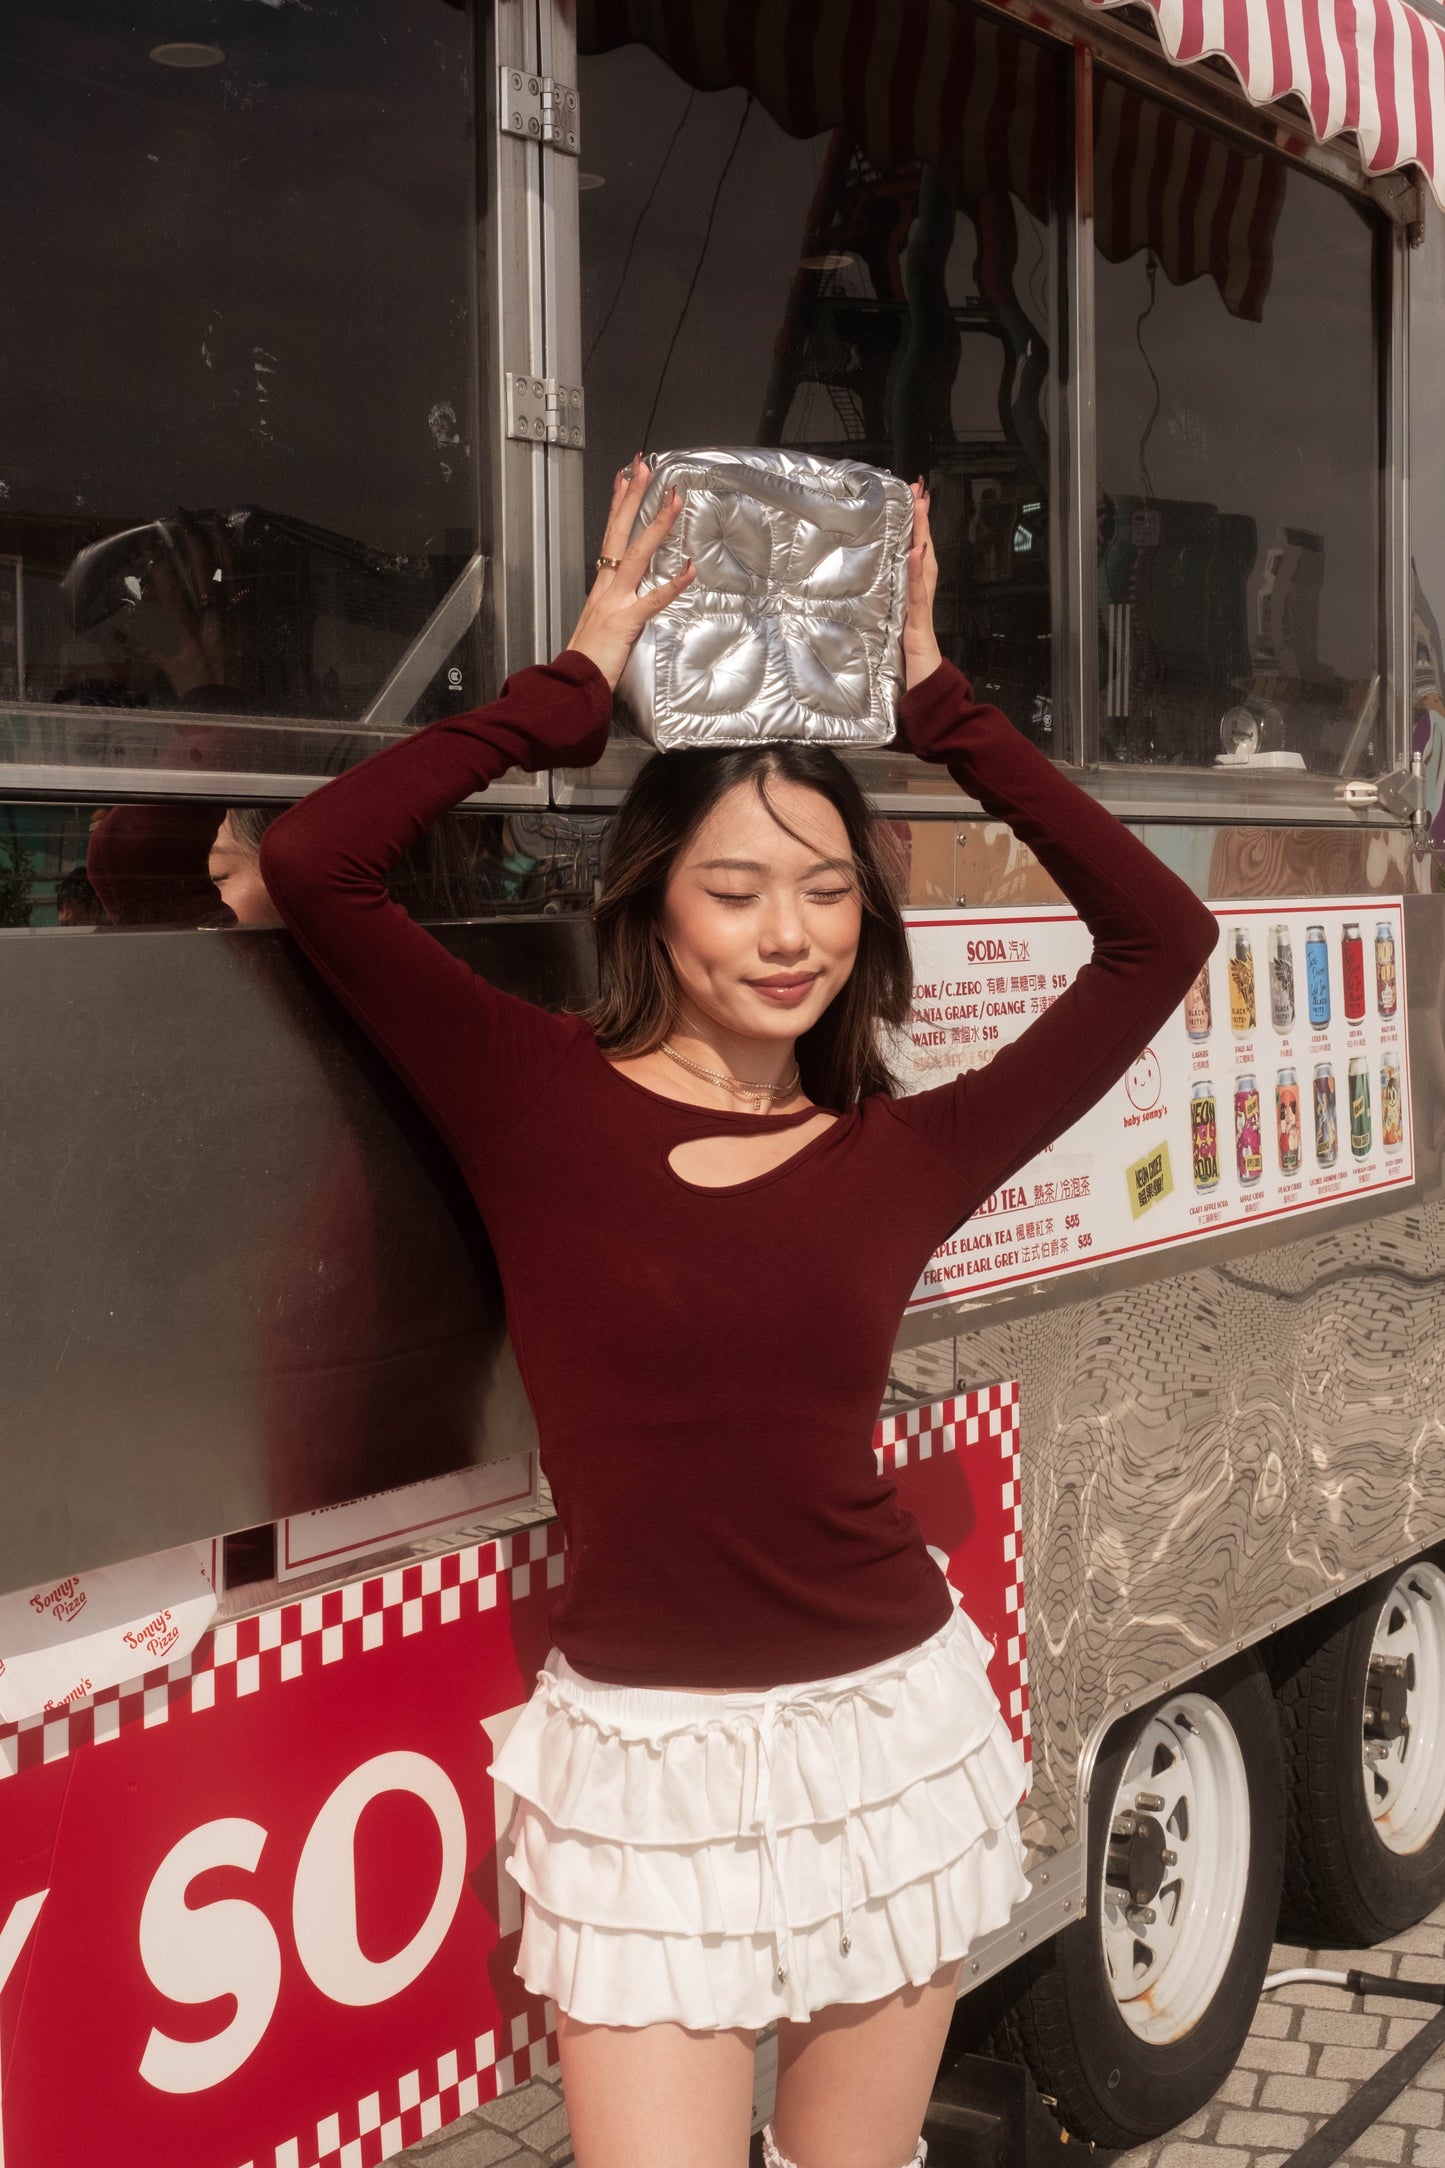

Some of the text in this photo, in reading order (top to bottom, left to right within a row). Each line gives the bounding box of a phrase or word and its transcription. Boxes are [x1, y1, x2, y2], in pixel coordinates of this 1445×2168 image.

[967, 939, 1030, 961] SODA 汽水
[1052, 974, 1067, 989] $15
[911, 1031, 946, 1047] WATER
[982, 1026, 998, 1041] $15
[1123, 1105, 1168, 1128] baby sonny's
[1190, 1100, 1216, 1127] NEON
[1193, 1157, 1218, 1179] SODA
[1001, 1186, 1027, 1210] TEA
[1189, 1200, 1229, 1215] CRAFT APPLE SODA
[1239, 1194, 1252, 1203] APPLE
[930, 1240, 957, 1260] APLE
[960, 1233, 992, 1253] BLACK
[995, 1229, 1012, 1245] TEA
[1065, 1213, 1080, 1230] $35
[923, 1264, 964, 1286] FRENCH
[967, 1257, 992, 1276] EARL
[994, 1250, 1019, 1269] GREY
[1078, 1233, 1093, 1249] $35
[29, 1575, 80, 1614] Sonny's
[53, 1591, 87, 1622] Pizza
[122, 1609, 172, 1650] Sonny's
[147, 1626, 179, 1656] Pizza
[139, 1705, 525, 2094] SO
